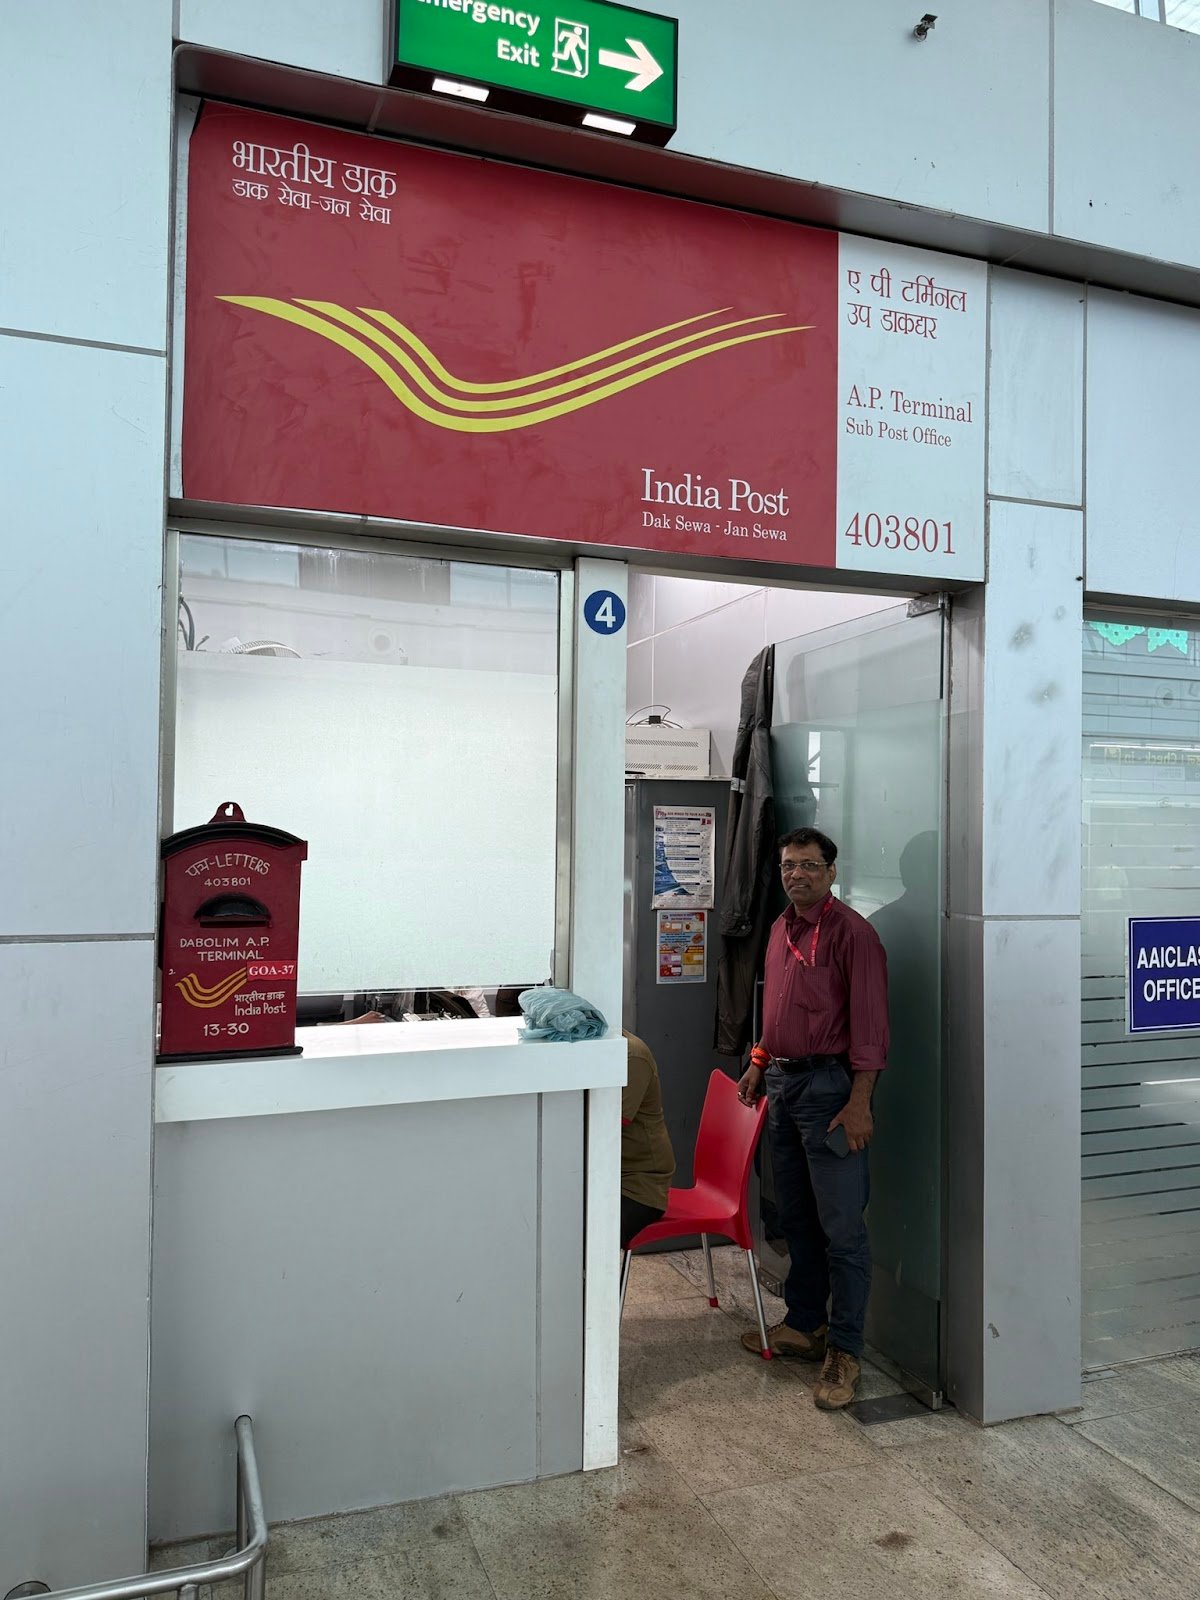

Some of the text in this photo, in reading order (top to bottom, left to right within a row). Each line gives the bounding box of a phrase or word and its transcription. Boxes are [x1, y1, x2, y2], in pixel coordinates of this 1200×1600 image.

[497, 38, 540, 67] Exit
[232, 140, 397, 199] भारतीय डाक
[232, 178, 269, 200] डाक
[358, 197, 392, 225] सेवा
[847, 267, 967, 312] ए पी टर्मिनल
[847, 302, 938, 340] उप डाकघर
[846, 384, 973, 423] A.P. Terminal
[846, 416, 952, 447] Sub Post Office
[641, 468, 790, 516] India Post
[642, 511, 671, 529] Dak
[675, 514, 711, 534] Sewa
[723, 520, 749, 538] Jan
[752, 523, 788, 541] Sewa
[845, 512, 956, 555] 403801
[595, 596, 616, 628] 4
[204, 877, 251, 887] 403801
[180, 936, 270, 948] DABOLIM A.P.
[197, 949, 264, 961] TERMINAL
[249, 964, 295, 976] GOA-37
[1136, 945, 1200, 969] AAICLA
[234, 990, 266, 1004] भारतीय
[1143, 978, 1200, 1002] OFFICE
[234, 1002, 287, 1017] India Post
[203, 1022, 250, 1036] 13-30
